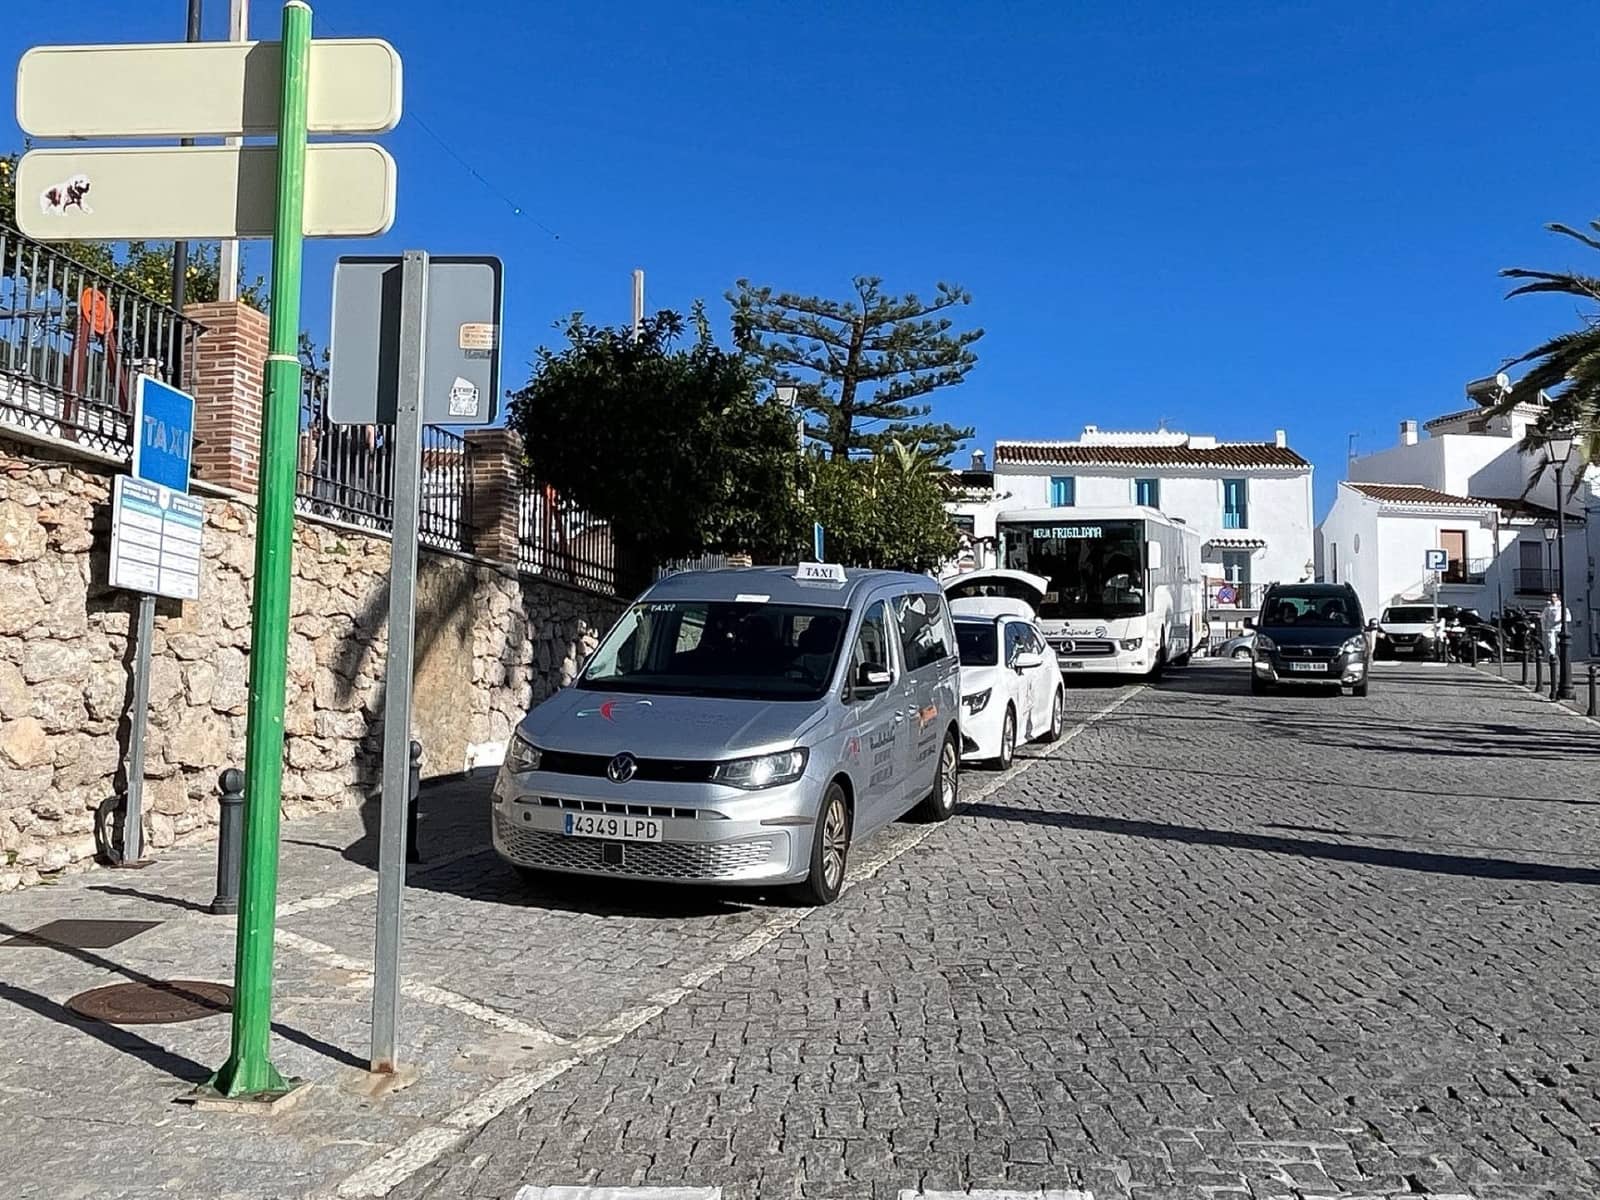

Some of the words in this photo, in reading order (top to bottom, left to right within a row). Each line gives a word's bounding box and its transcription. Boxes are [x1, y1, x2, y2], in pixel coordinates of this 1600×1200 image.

[143, 414, 188, 460] TAXI
[1052, 527, 1102, 538] FRIGILIANA
[1429, 552, 1443, 569] P
[805, 567, 833, 578] TAXI
[575, 816, 618, 836] 4349
[623, 820, 657, 839] LPD
